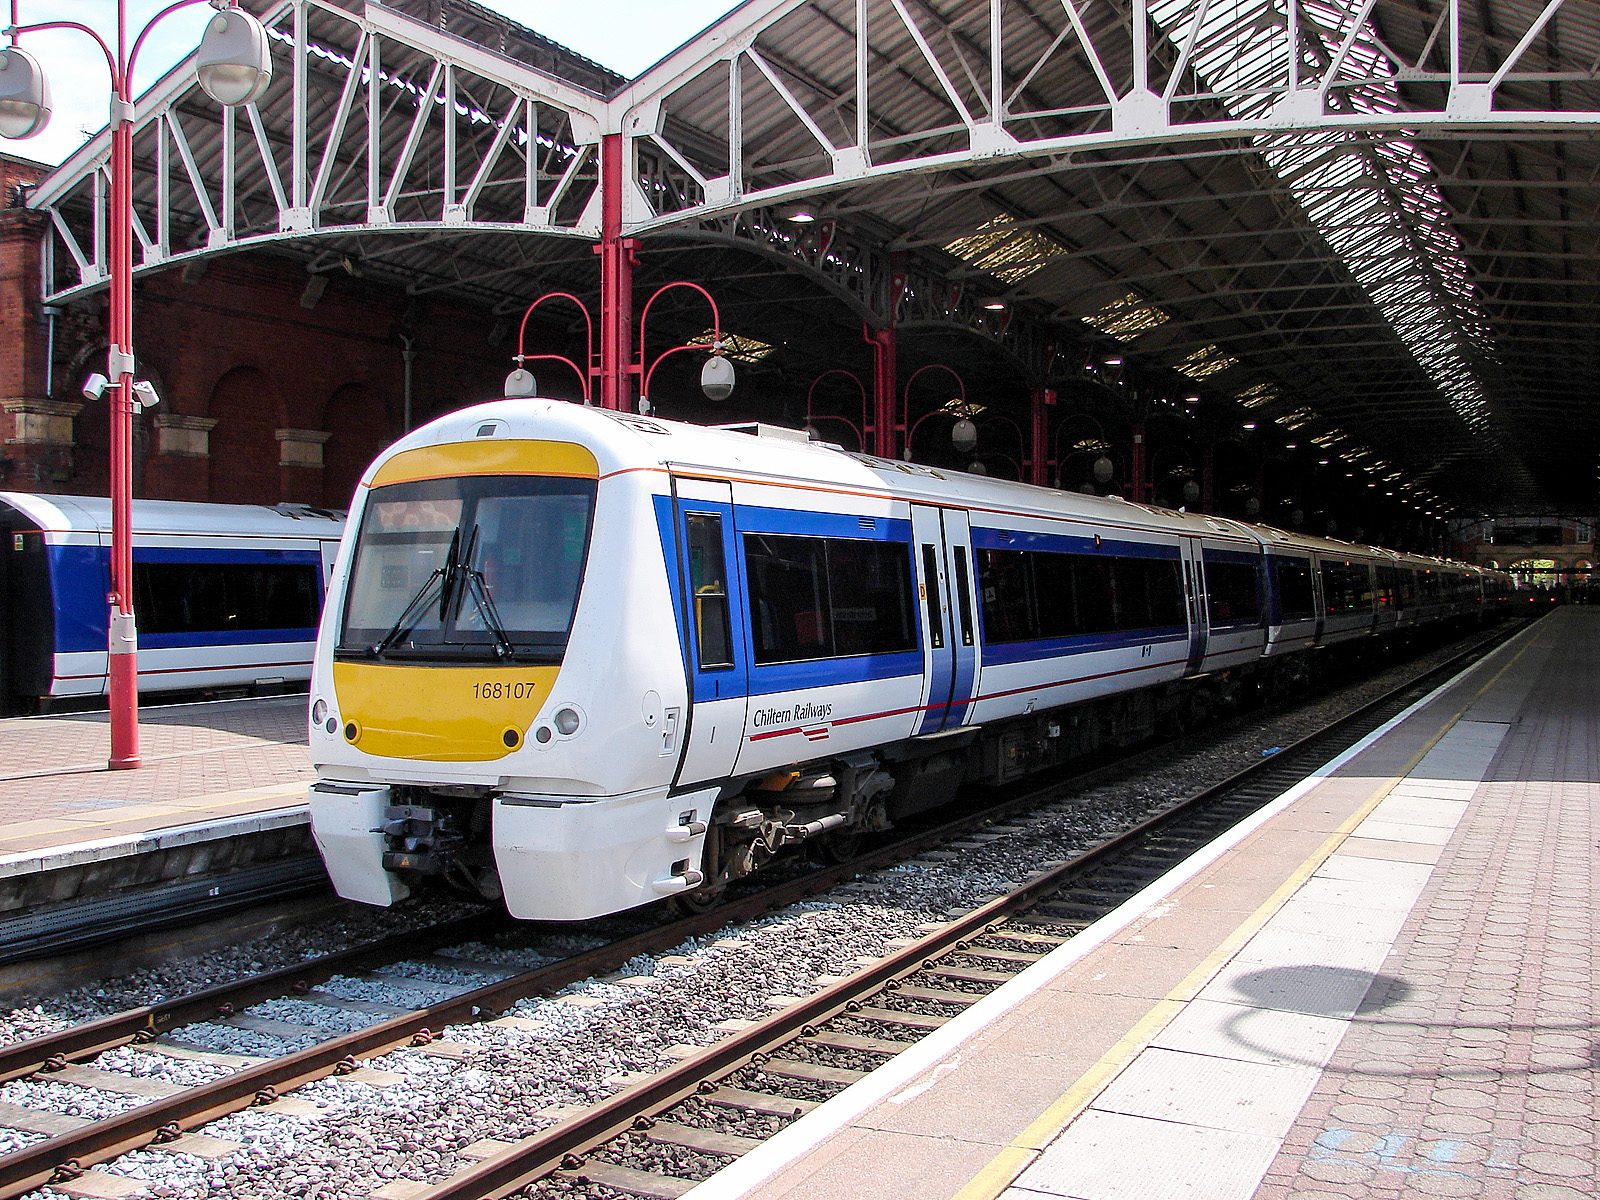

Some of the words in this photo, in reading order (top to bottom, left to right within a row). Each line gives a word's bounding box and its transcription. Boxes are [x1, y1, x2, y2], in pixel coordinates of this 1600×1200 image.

[472, 682, 536, 699] 168107
[753, 707, 791, 728] Chiltern
[793, 702, 833, 721] Railways
